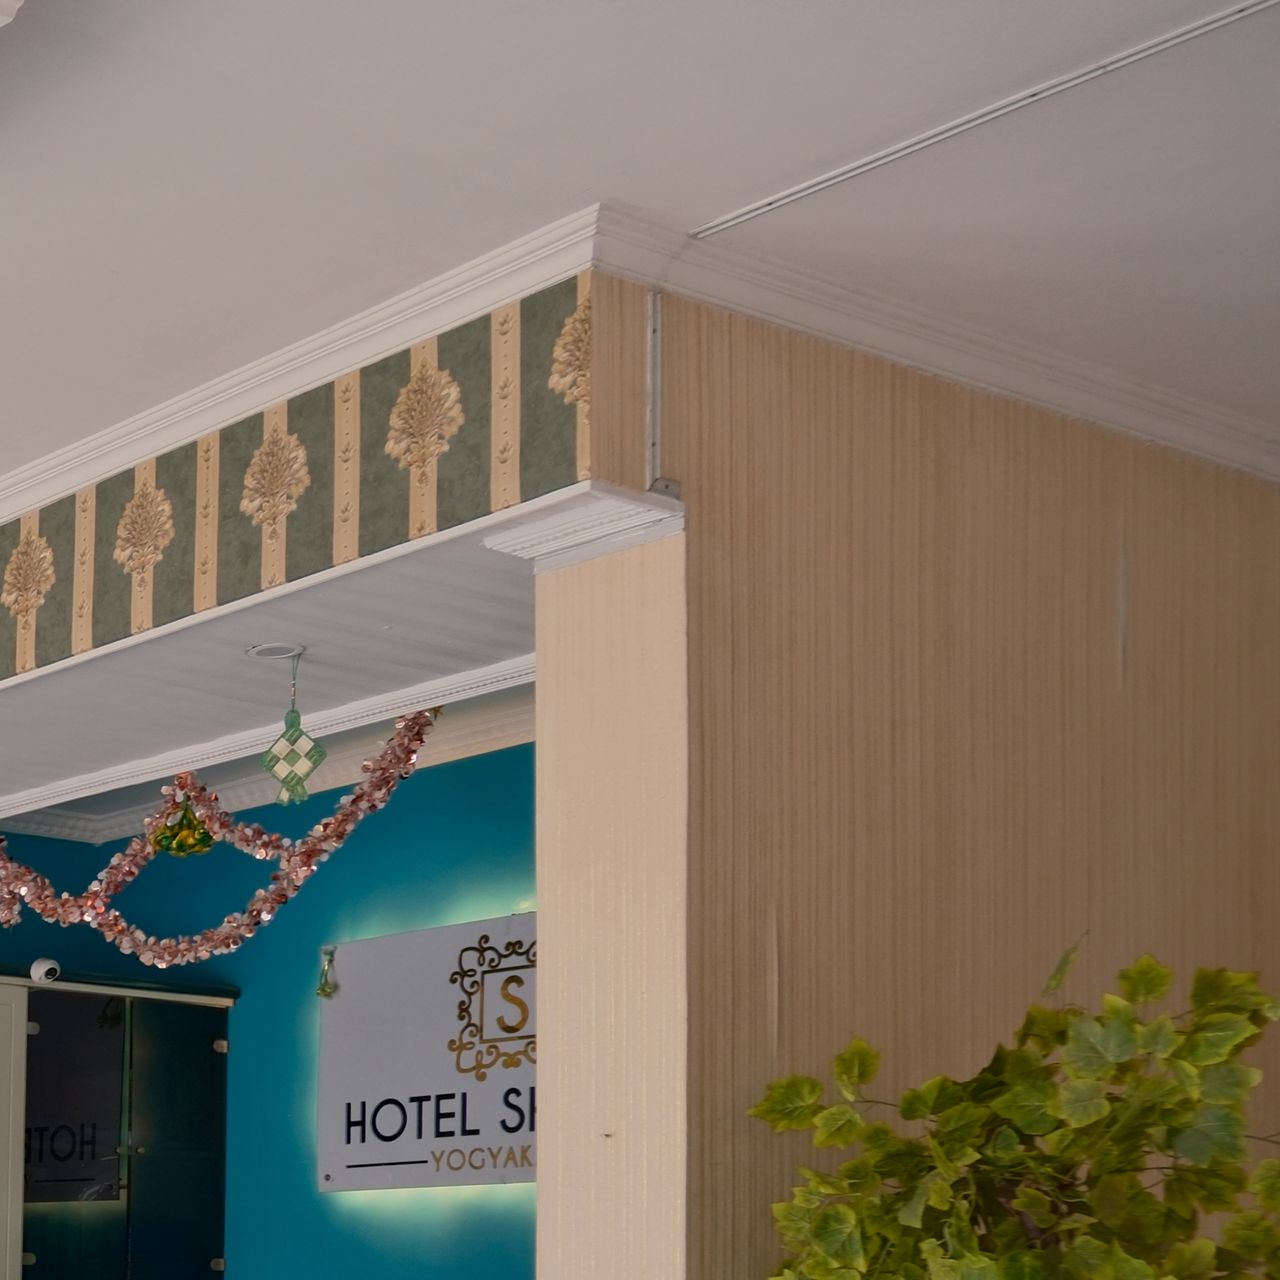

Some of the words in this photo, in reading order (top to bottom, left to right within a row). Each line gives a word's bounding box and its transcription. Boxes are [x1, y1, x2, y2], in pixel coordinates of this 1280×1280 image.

[495, 974, 530, 1034] S
[344, 1091, 481, 1145] HOTEL
[430, 1145, 537, 1172] YOGYAK
